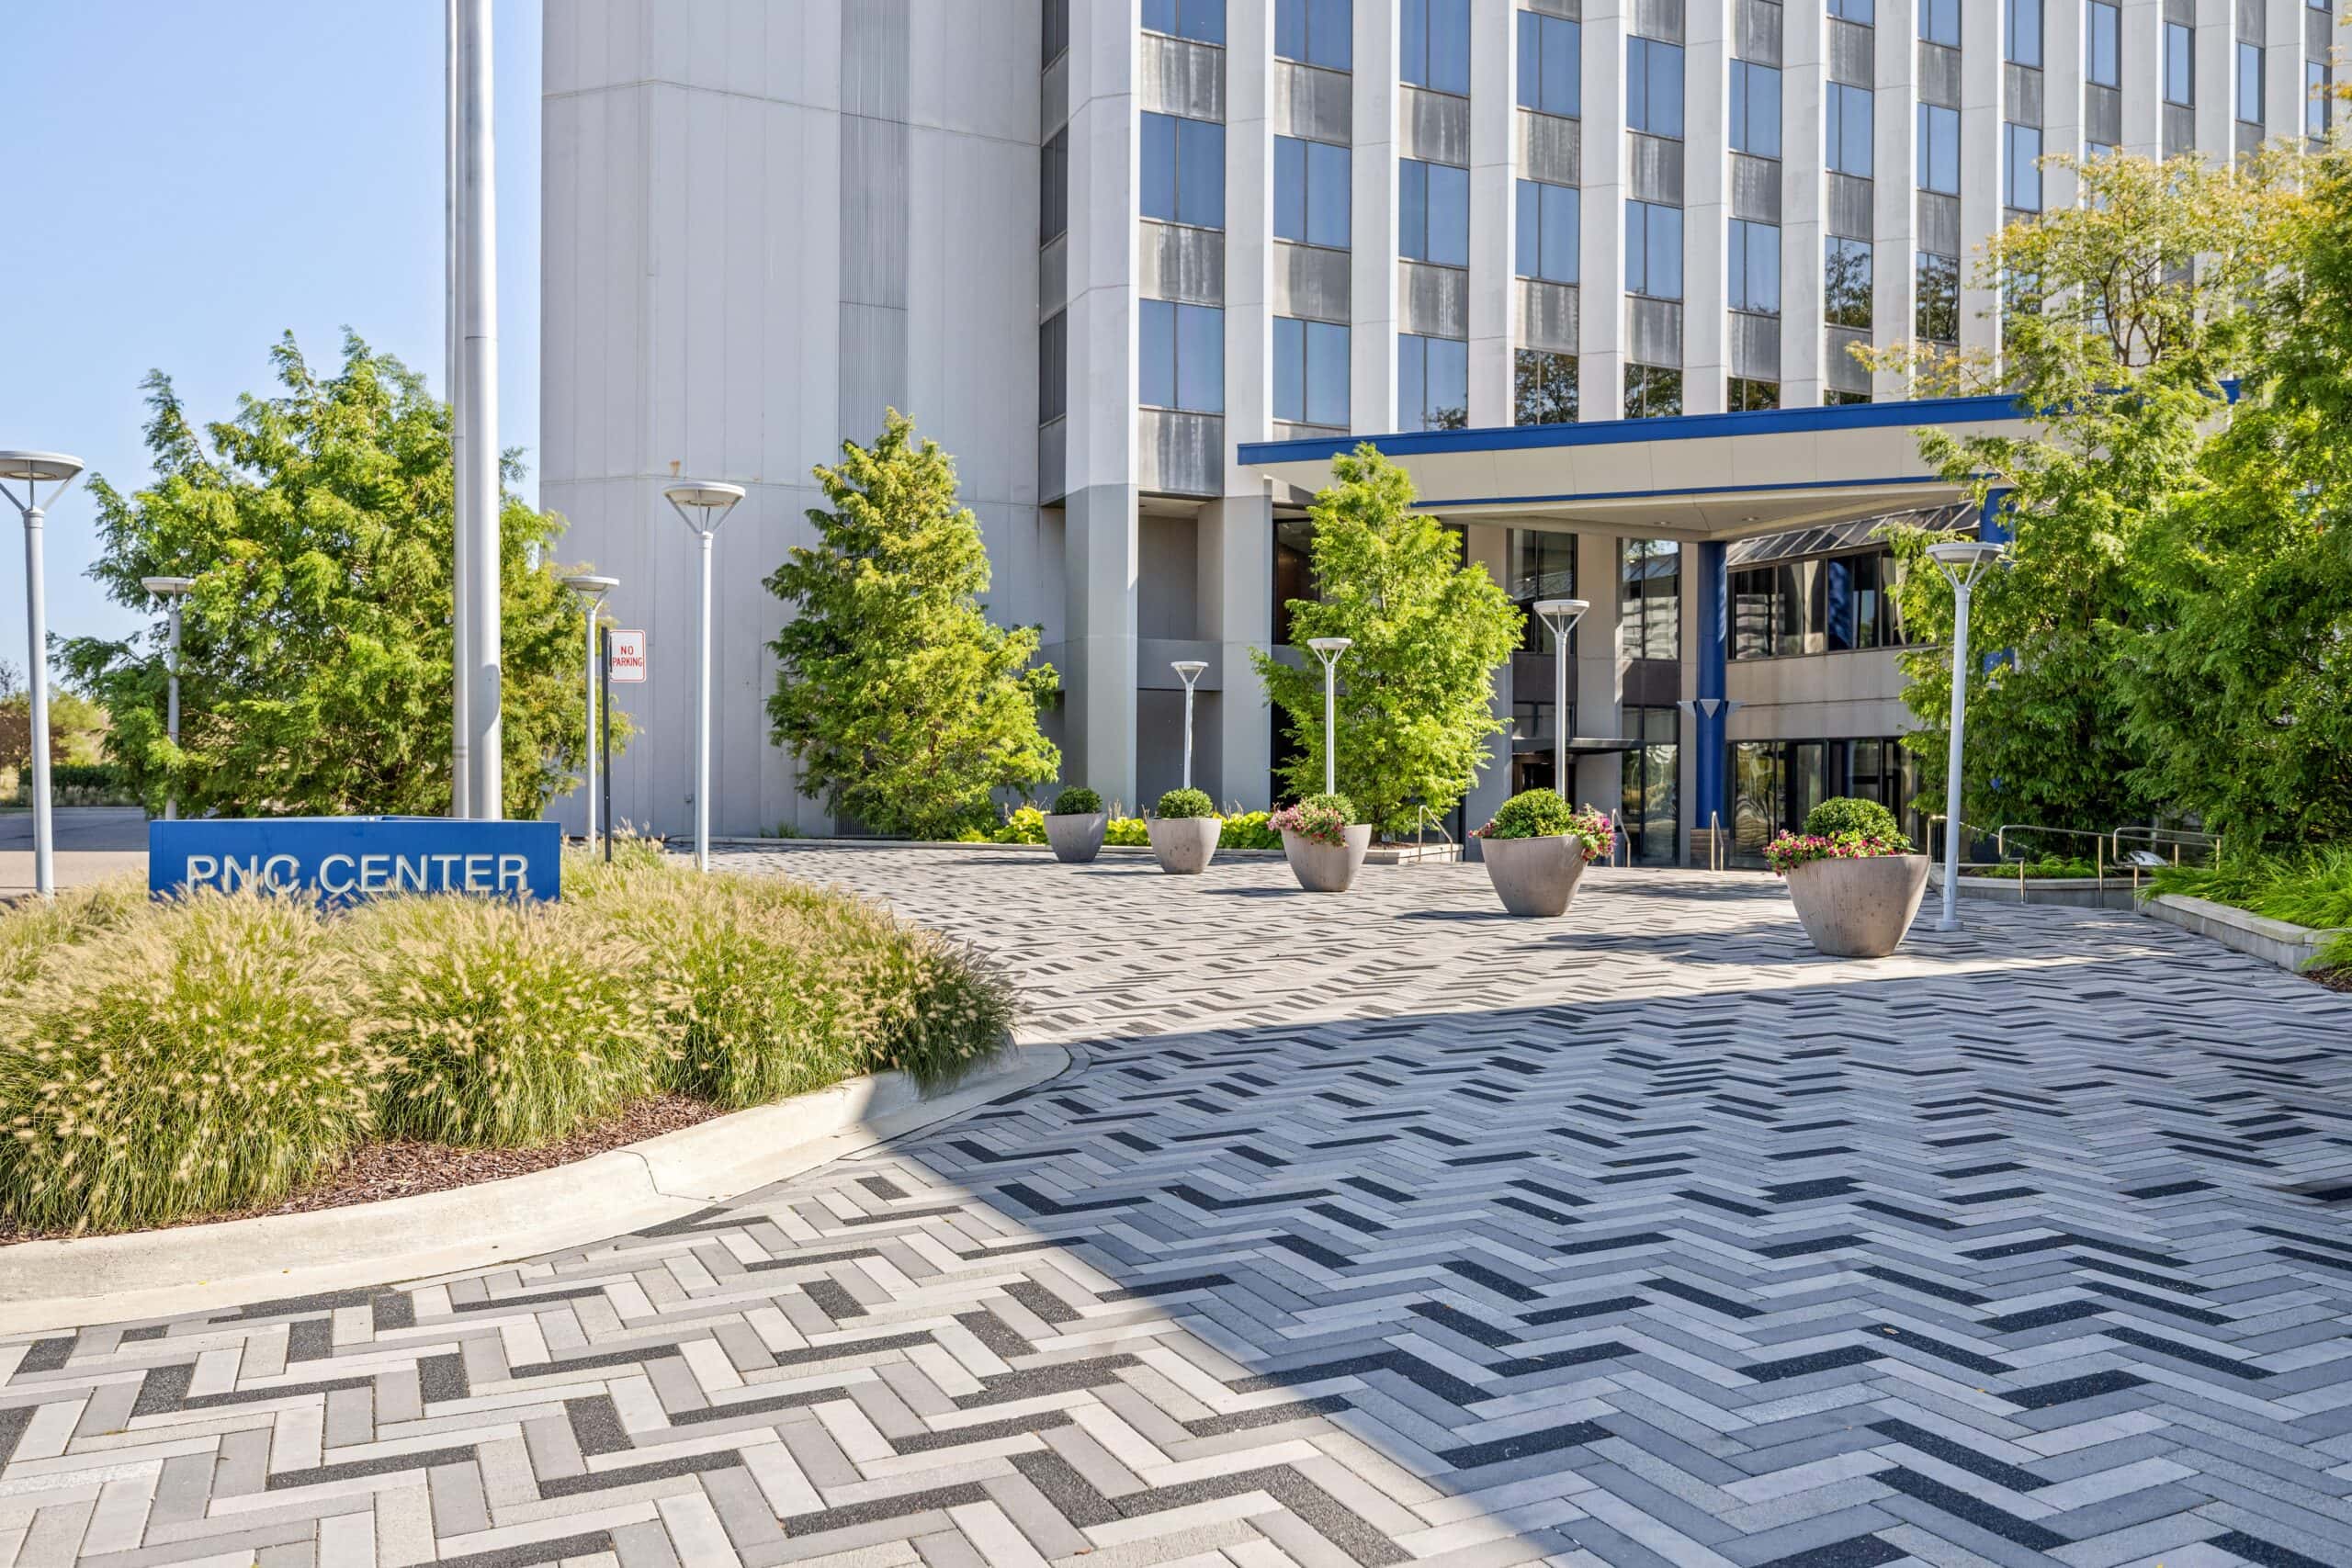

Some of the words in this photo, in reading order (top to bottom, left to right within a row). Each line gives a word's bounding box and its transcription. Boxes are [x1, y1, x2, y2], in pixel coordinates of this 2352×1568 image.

[620, 646, 634, 655] NO
[612, 657, 643, 667] PARKING
[186, 854, 300, 894] PNC
[319, 854, 528, 894] CENTER
